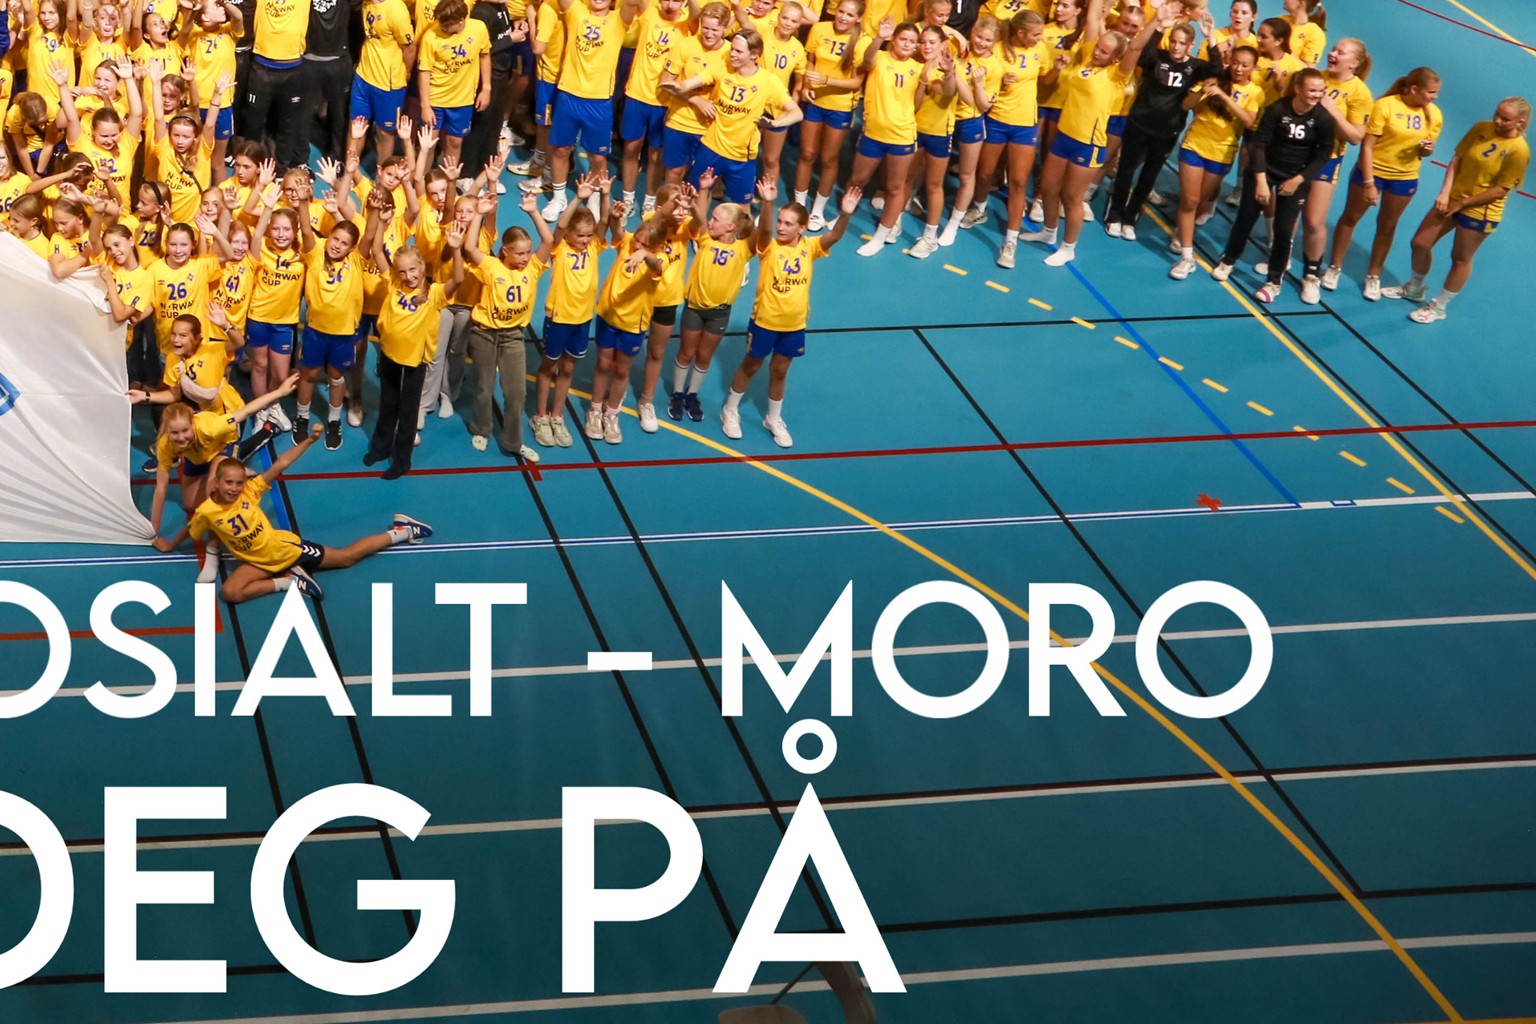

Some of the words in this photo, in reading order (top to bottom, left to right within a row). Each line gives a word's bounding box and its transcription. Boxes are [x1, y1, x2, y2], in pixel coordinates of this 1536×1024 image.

[955, 0, 963, 13] 1
[584, 26, 601, 40] 25
[657, 30, 670, 45] 14
[451, 44, 467, 58] 34
[830, 41, 845, 56] 13
[774, 54, 788, 69] 10
[1019, 54, 1026, 69] 2
[895, 74, 904, 88] 11
[1168, 71, 1183, 88] 12
[248, 93, 257, 104] 11
[730, 86, 745, 103] 13
[1405, 114, 1422, 131] 18
[1288, 123, 1306, 140] 16
[1481, 143, 1497, 158] 2
[783, 257, 801, 275] 43
[167, 282, 188, 300] 26
[505, 286, 523, 303] 61
[228, 513, 249, 537] 31
[412, 525, 422, 535] N
